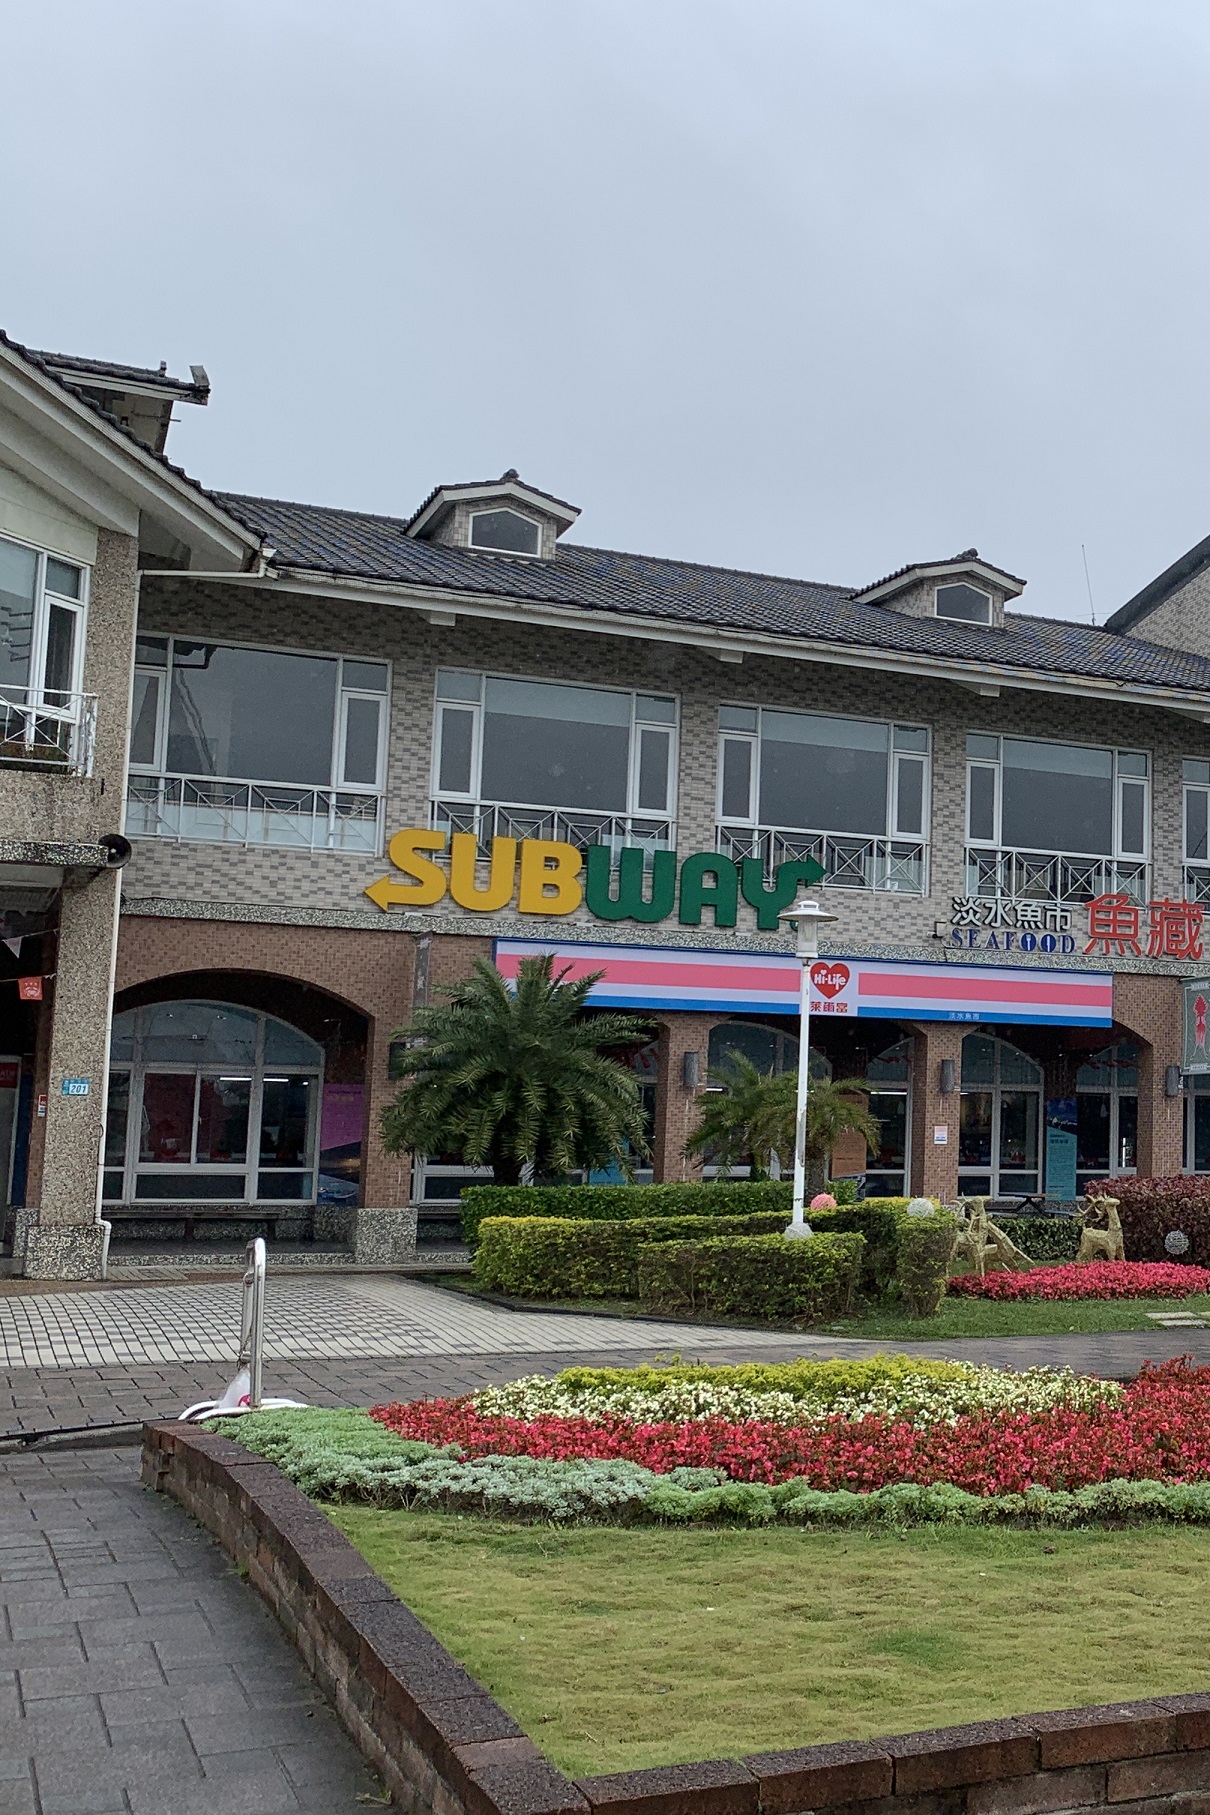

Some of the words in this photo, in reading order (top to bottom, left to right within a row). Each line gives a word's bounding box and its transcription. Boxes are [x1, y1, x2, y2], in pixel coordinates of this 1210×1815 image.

[364, 829, 828, 931] SUBWAY
[951, 897, 1073, 932] 淡水魚市
[1083, 893, 1204, 960] 魚藏
[951, 928, 1075, 954] SEAFOOD
[810, 1001, 848, 1013] 萊爾富
[948, 1012, 980, 1020] 淡水魚市
[70, 1085, 87, 1093] 201
